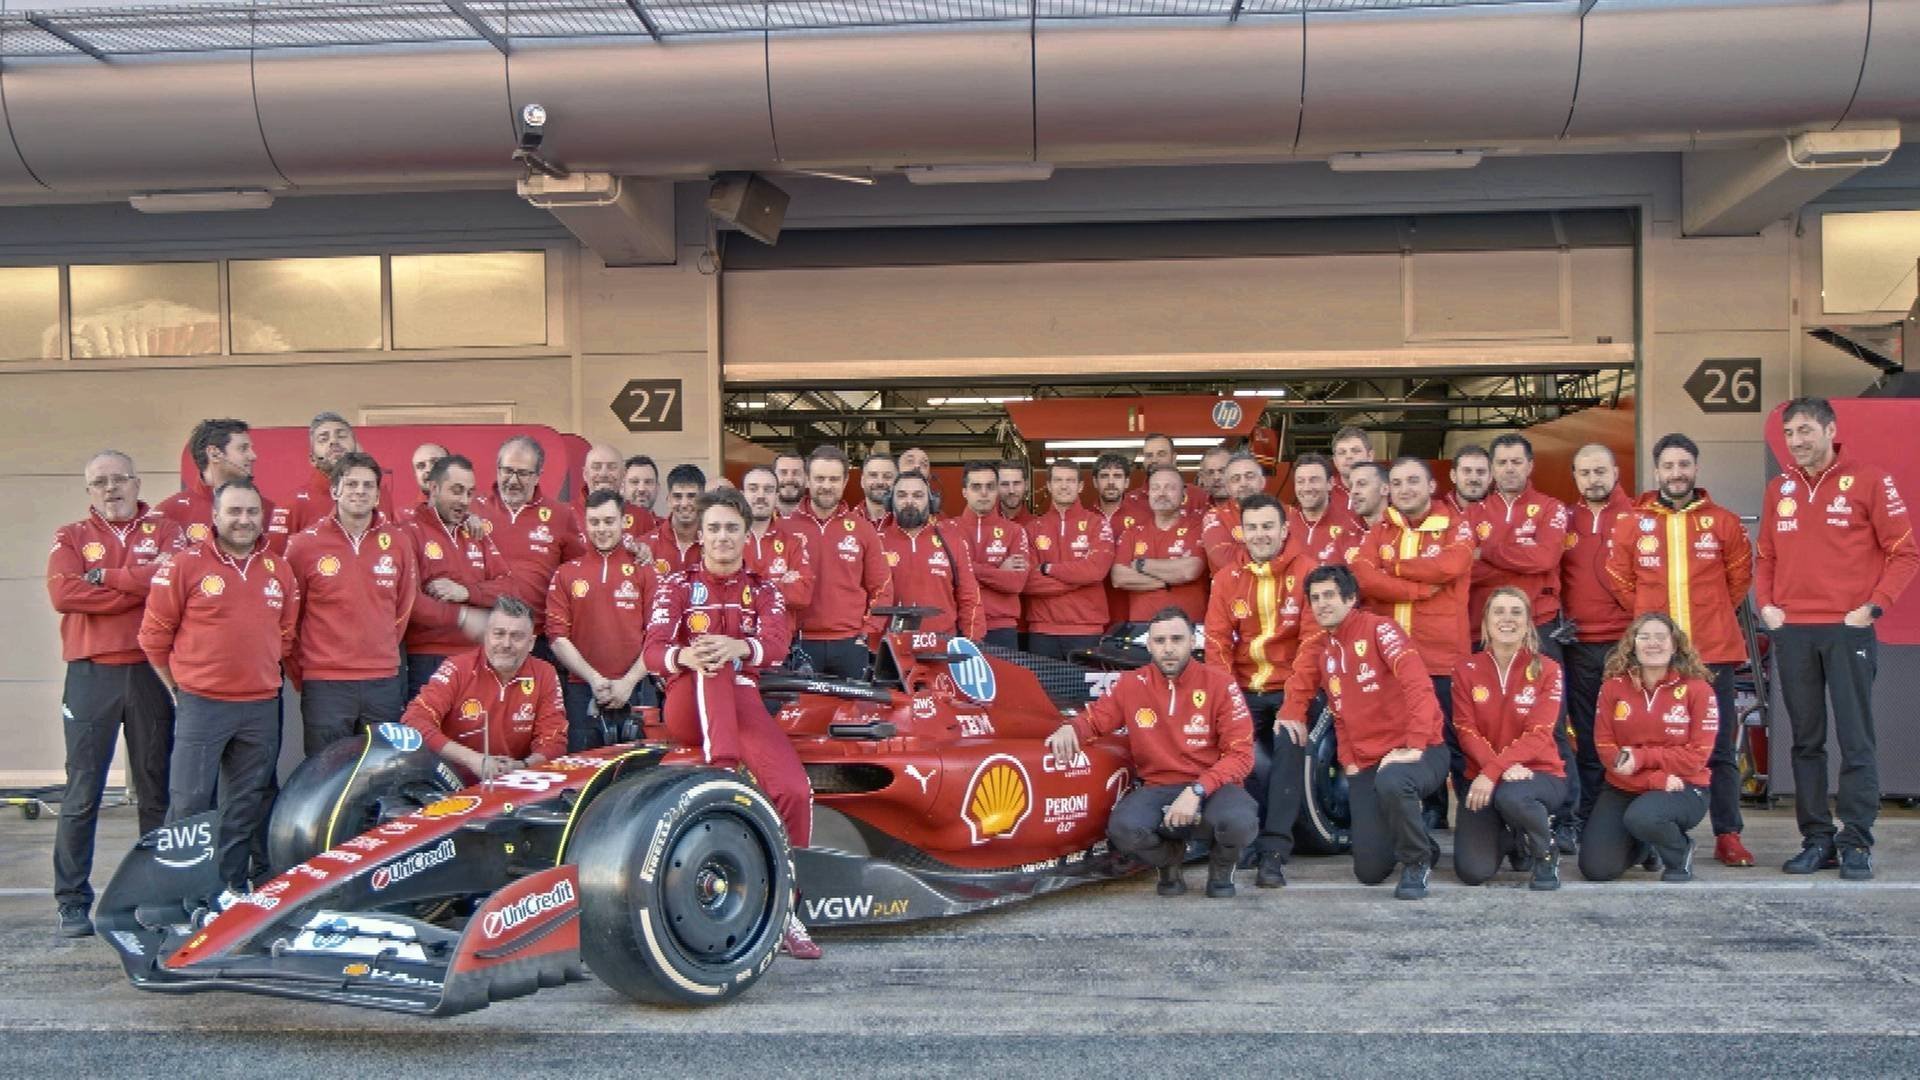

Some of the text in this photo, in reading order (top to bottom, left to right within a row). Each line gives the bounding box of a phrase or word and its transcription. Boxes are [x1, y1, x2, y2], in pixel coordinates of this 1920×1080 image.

[1703, 367, 1753, 403] 26
[629, 388, 676, 422] 27
[912, 632, 937, 649] ZCG
[384, 722, 417, 752] hp
[955, 713, 996, 738] IBM
[1045, 793, 1089, 816] PERONI
[156, 821, 212, 851] aws
[389, 838, 456, 882] UniCredit
[501, 879, 575, 929] UniCredit
[804, 894, 910, 920] VGW PLAY
